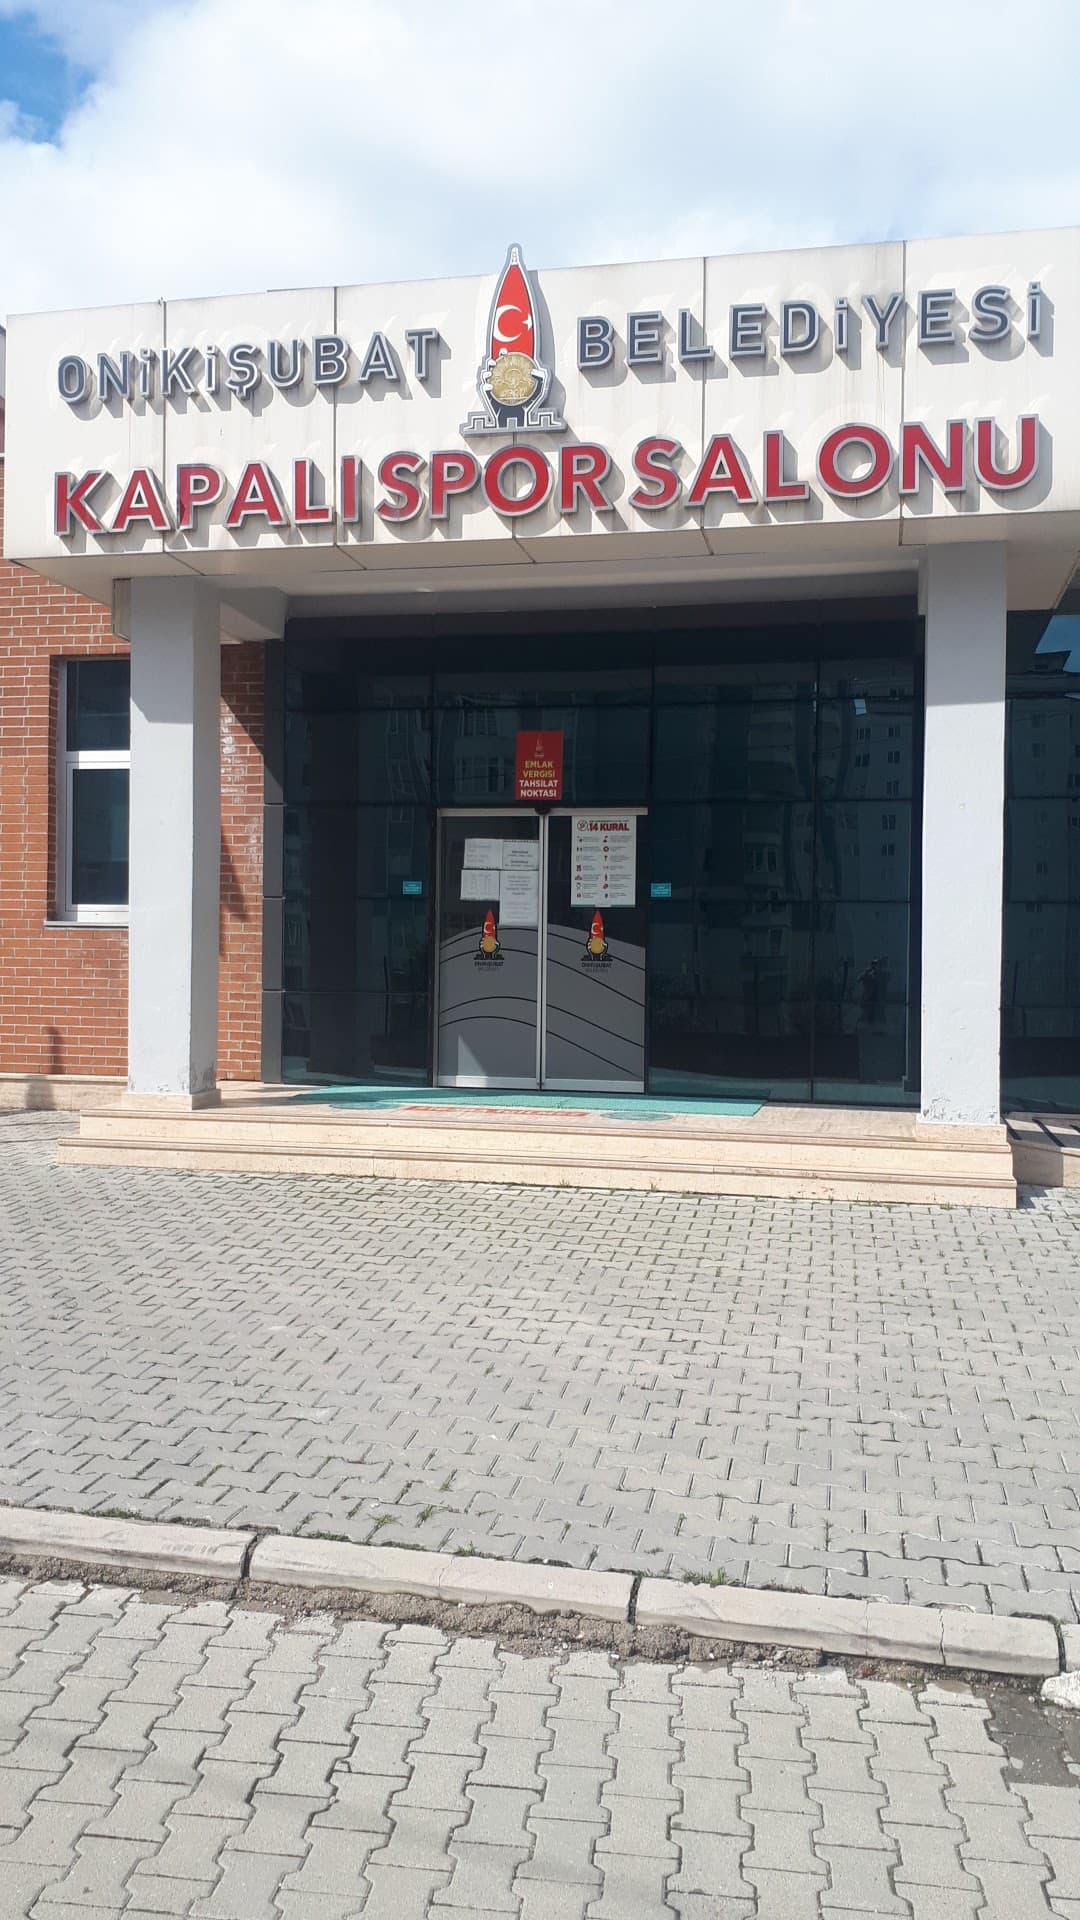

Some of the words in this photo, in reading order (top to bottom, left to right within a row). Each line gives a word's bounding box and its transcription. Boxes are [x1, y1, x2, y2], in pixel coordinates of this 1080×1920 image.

[525, 760, 553, 769] EMLAK
[520, 789, 557, 798] NOKTASI
[588, 822, 598, 831] 14
[600, 822, 629, 831] KURAL
